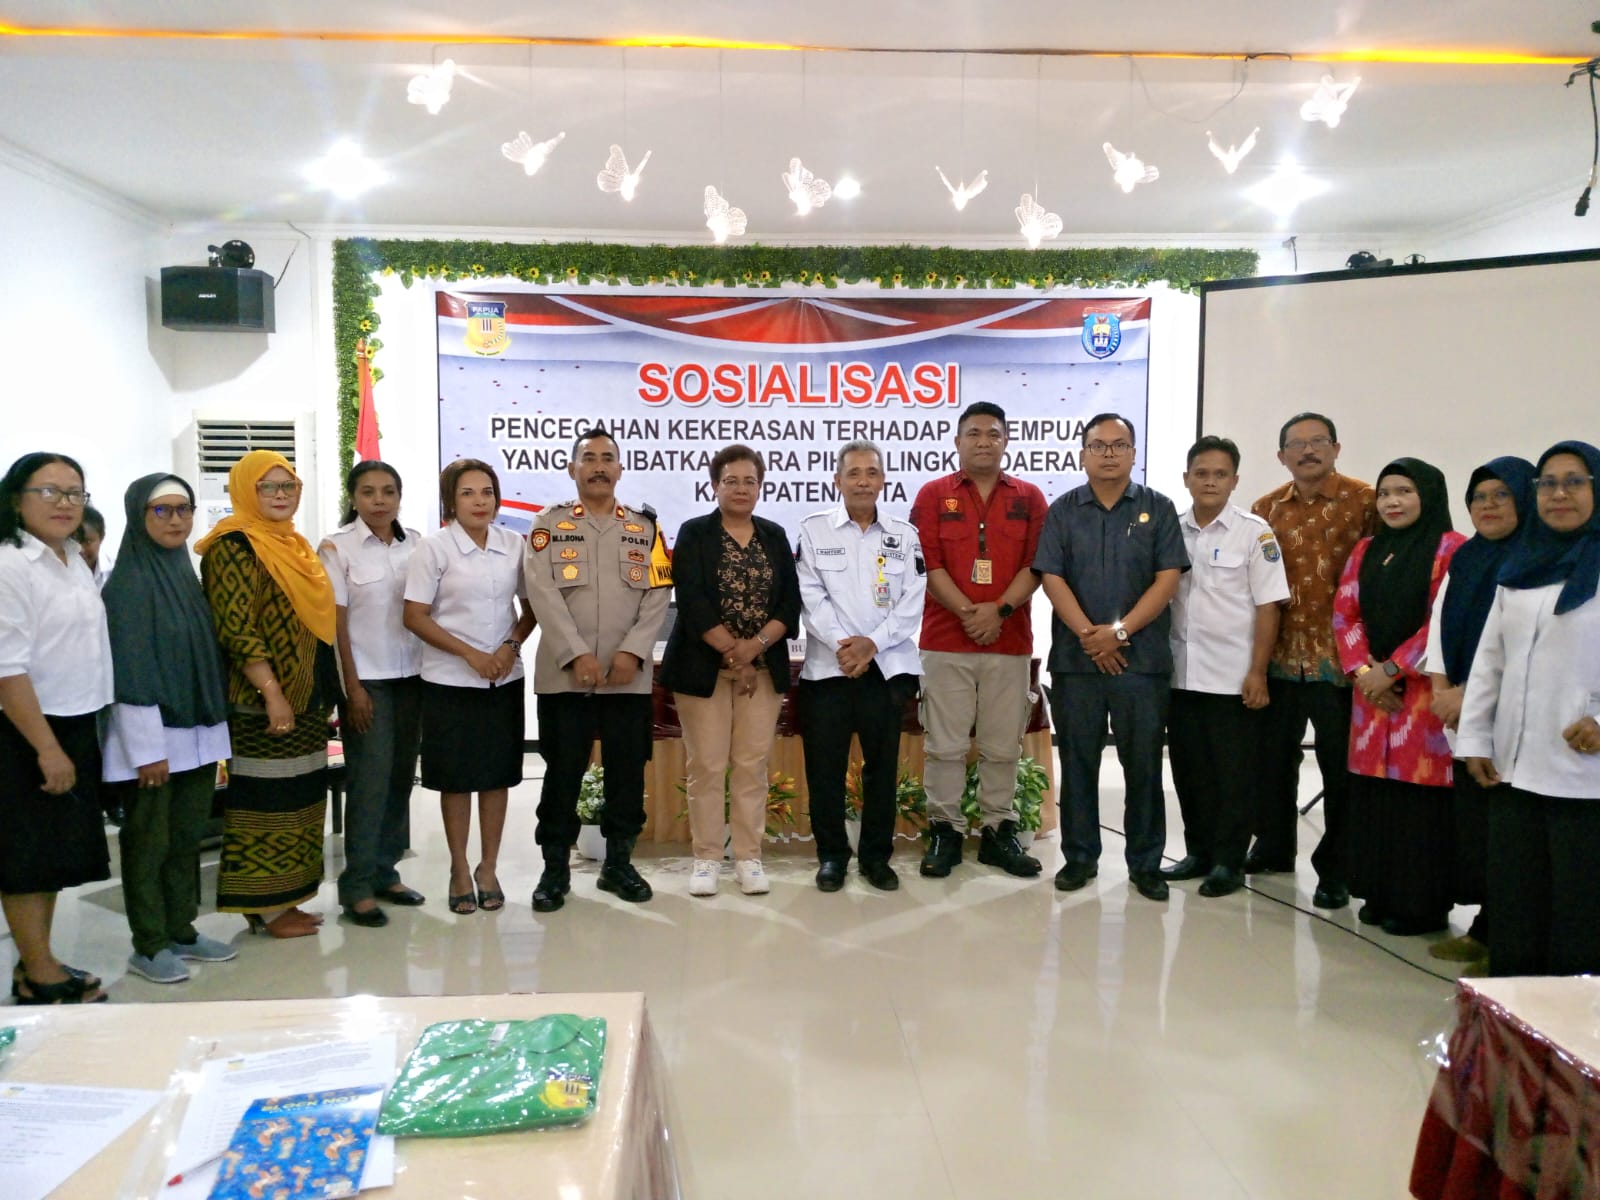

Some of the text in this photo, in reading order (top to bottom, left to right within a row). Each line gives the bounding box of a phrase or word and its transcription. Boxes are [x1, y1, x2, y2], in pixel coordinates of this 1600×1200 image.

[638, 362, 960, 406] SOSIALISASI
[668, 419, 814, 441] KEKERASAN
[823, 419, 951, 441] TERHADAP
[502, 449, 568, 471] YANG
[621, 535, 649, 546] POLRI
